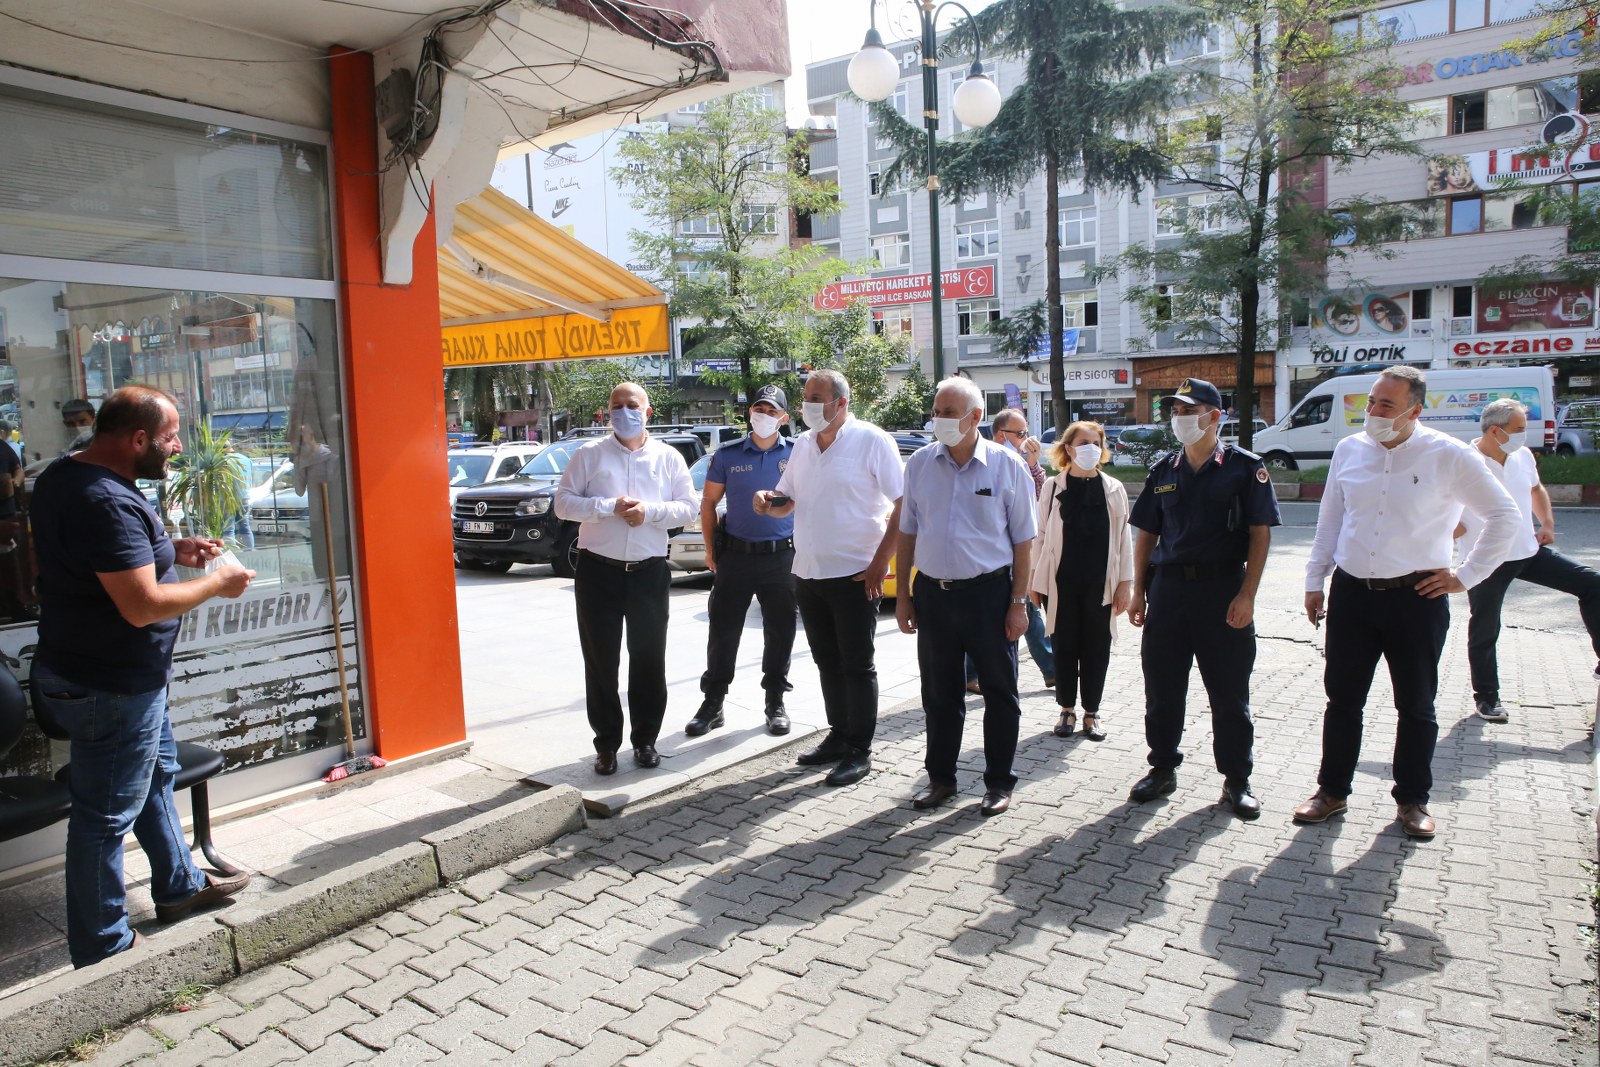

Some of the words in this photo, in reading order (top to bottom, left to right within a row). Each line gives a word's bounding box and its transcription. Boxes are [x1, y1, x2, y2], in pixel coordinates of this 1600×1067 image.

[627, 163, 645, 174] CAT
[554, 197, 571, 209] NIKE
[886, 275, 925, 290] HAREKET
[927, 272, 961, 285] PRTİSİ
[1354, 343, 1405, 361] OPTİK
[1453, 335, 1573, 356] eczane
